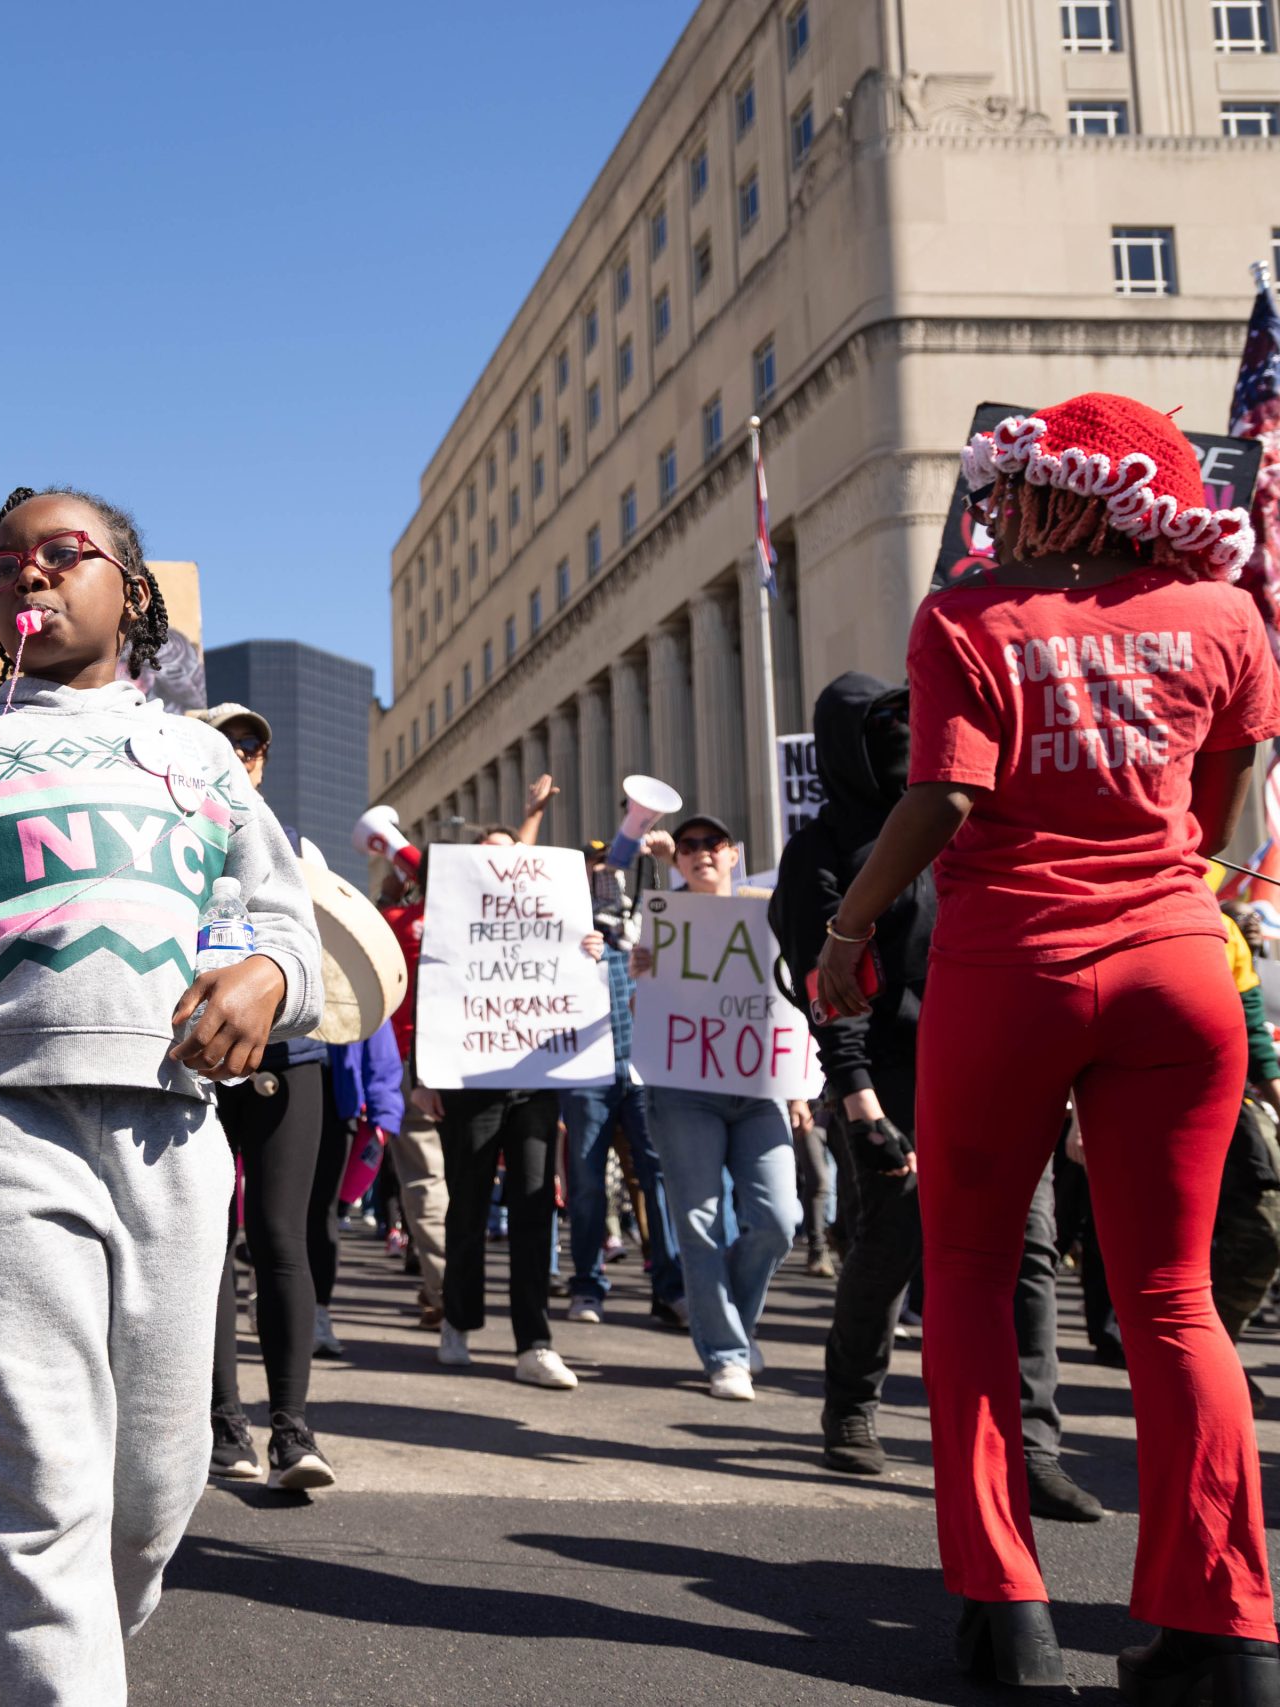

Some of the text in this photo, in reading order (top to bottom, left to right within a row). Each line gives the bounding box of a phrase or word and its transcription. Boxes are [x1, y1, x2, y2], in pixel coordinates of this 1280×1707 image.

[1004, 631, 1193, 687] SOCIALISM
[1043, 679, 1156, 728] IS THE
[1031, 724, 1170, 775] FUTURE
[171, 773, 206, 791] TRUMP
[17, 810, 206, 896] NYC
[488, 856, 551, 882] WAR
[512, 881, 527, 895] IS
[482, 893, 554, 919] PEACE
[470, 919, 564, 945] FREEDOM
[502, 944, 523, 961] IS
[650, 916, 765, 985] PLA
[465, 956, 560, 985] SLAVERY
[463, 994, 583, 1023] IGNORANCE
[720, 995, 778, 1021] OVER
[463, 1026, 578, 1054] STRENGTH
[667, 1013, 813, 1080] PROFI
